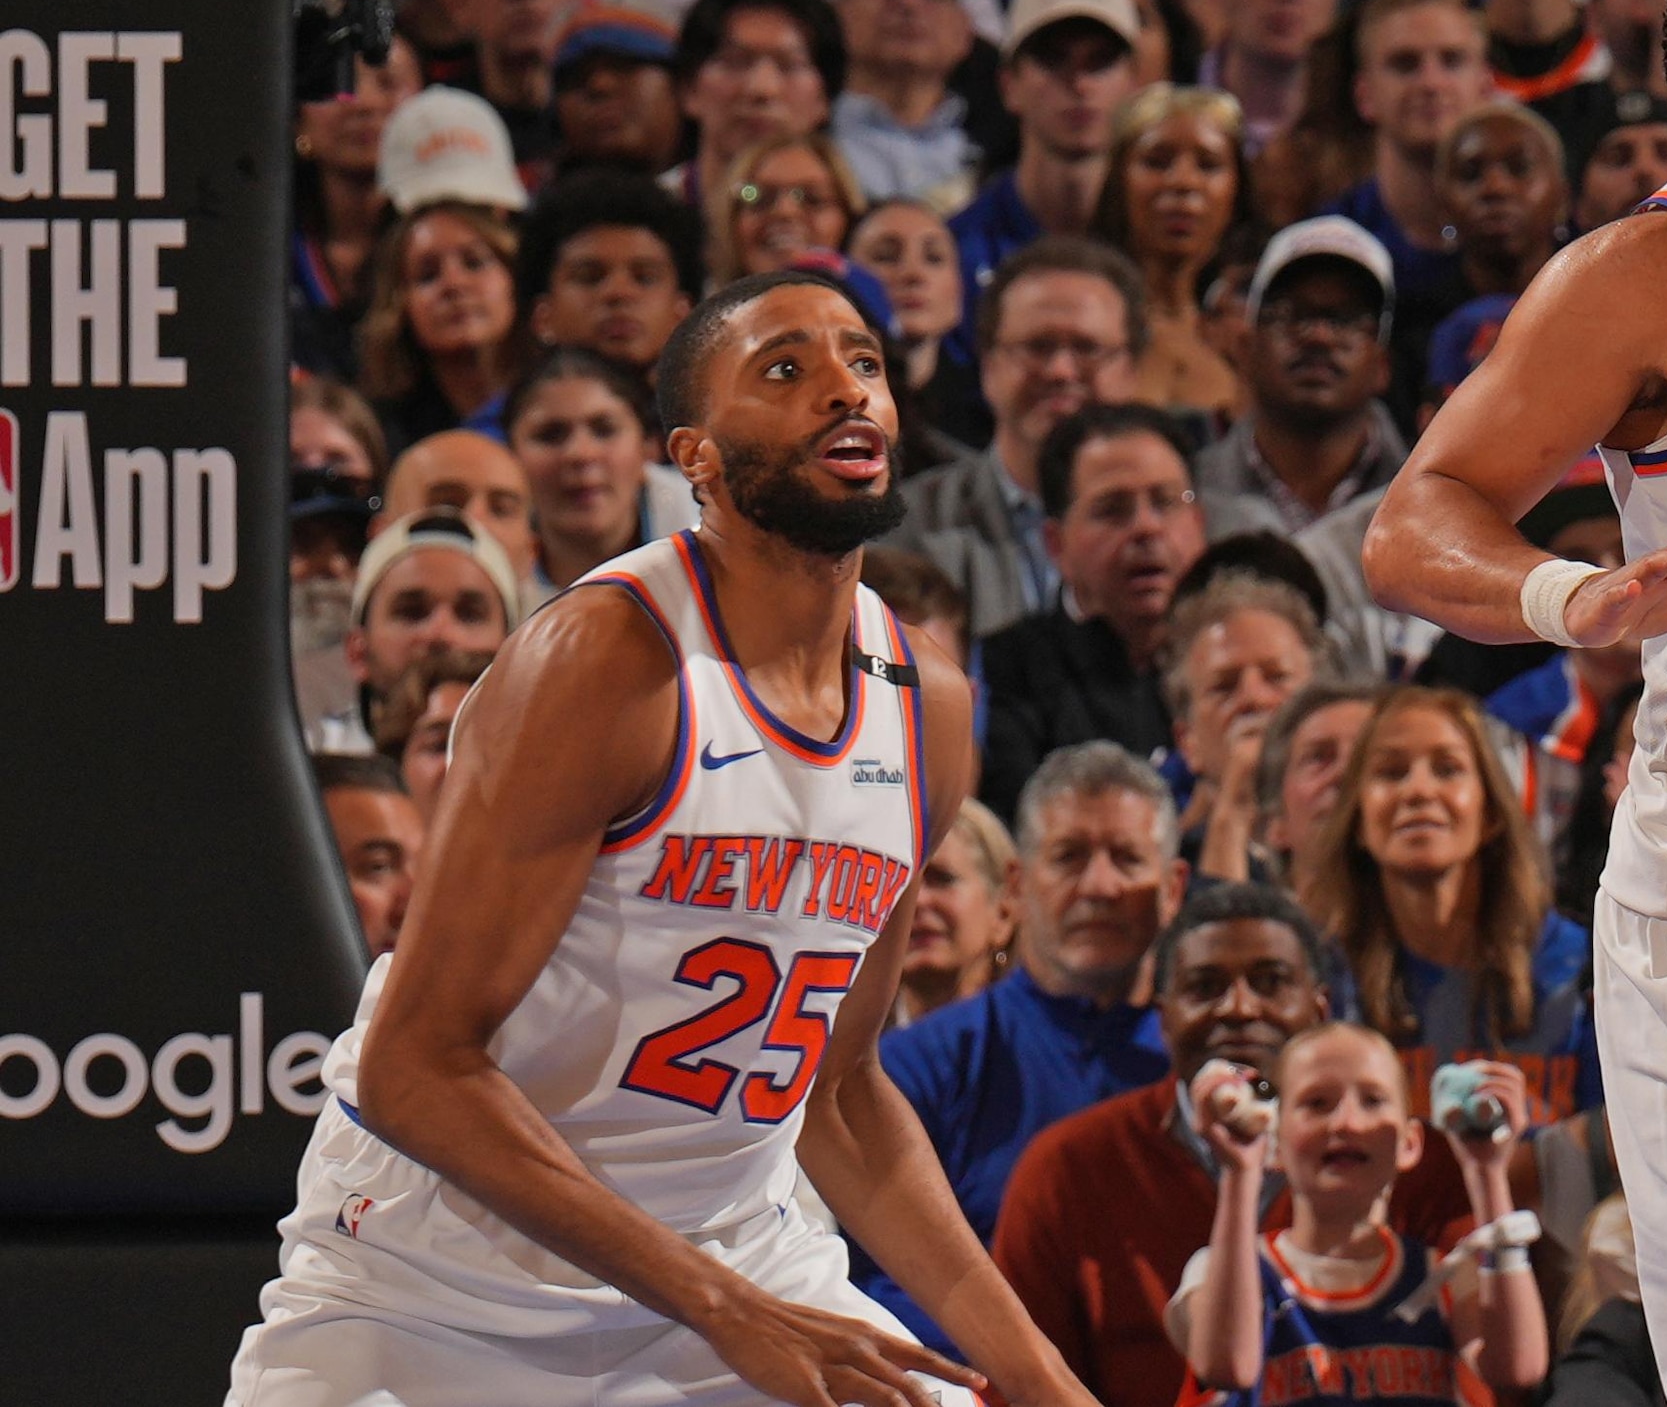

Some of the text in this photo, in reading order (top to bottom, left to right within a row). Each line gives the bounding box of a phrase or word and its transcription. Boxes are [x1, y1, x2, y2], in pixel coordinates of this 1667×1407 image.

[0, 29, 184, 201] GET
[0, 218, 188, 387] THE
[31, 410, 238, 624] App
[870, 656, 888, 679] 12
[853, 767, 904, 784] abu dhab
[639, 834, 911, 935] NEW YORK
[0, 991, 337, 1154] oogle
[618, 936, 862, 1125] 25
